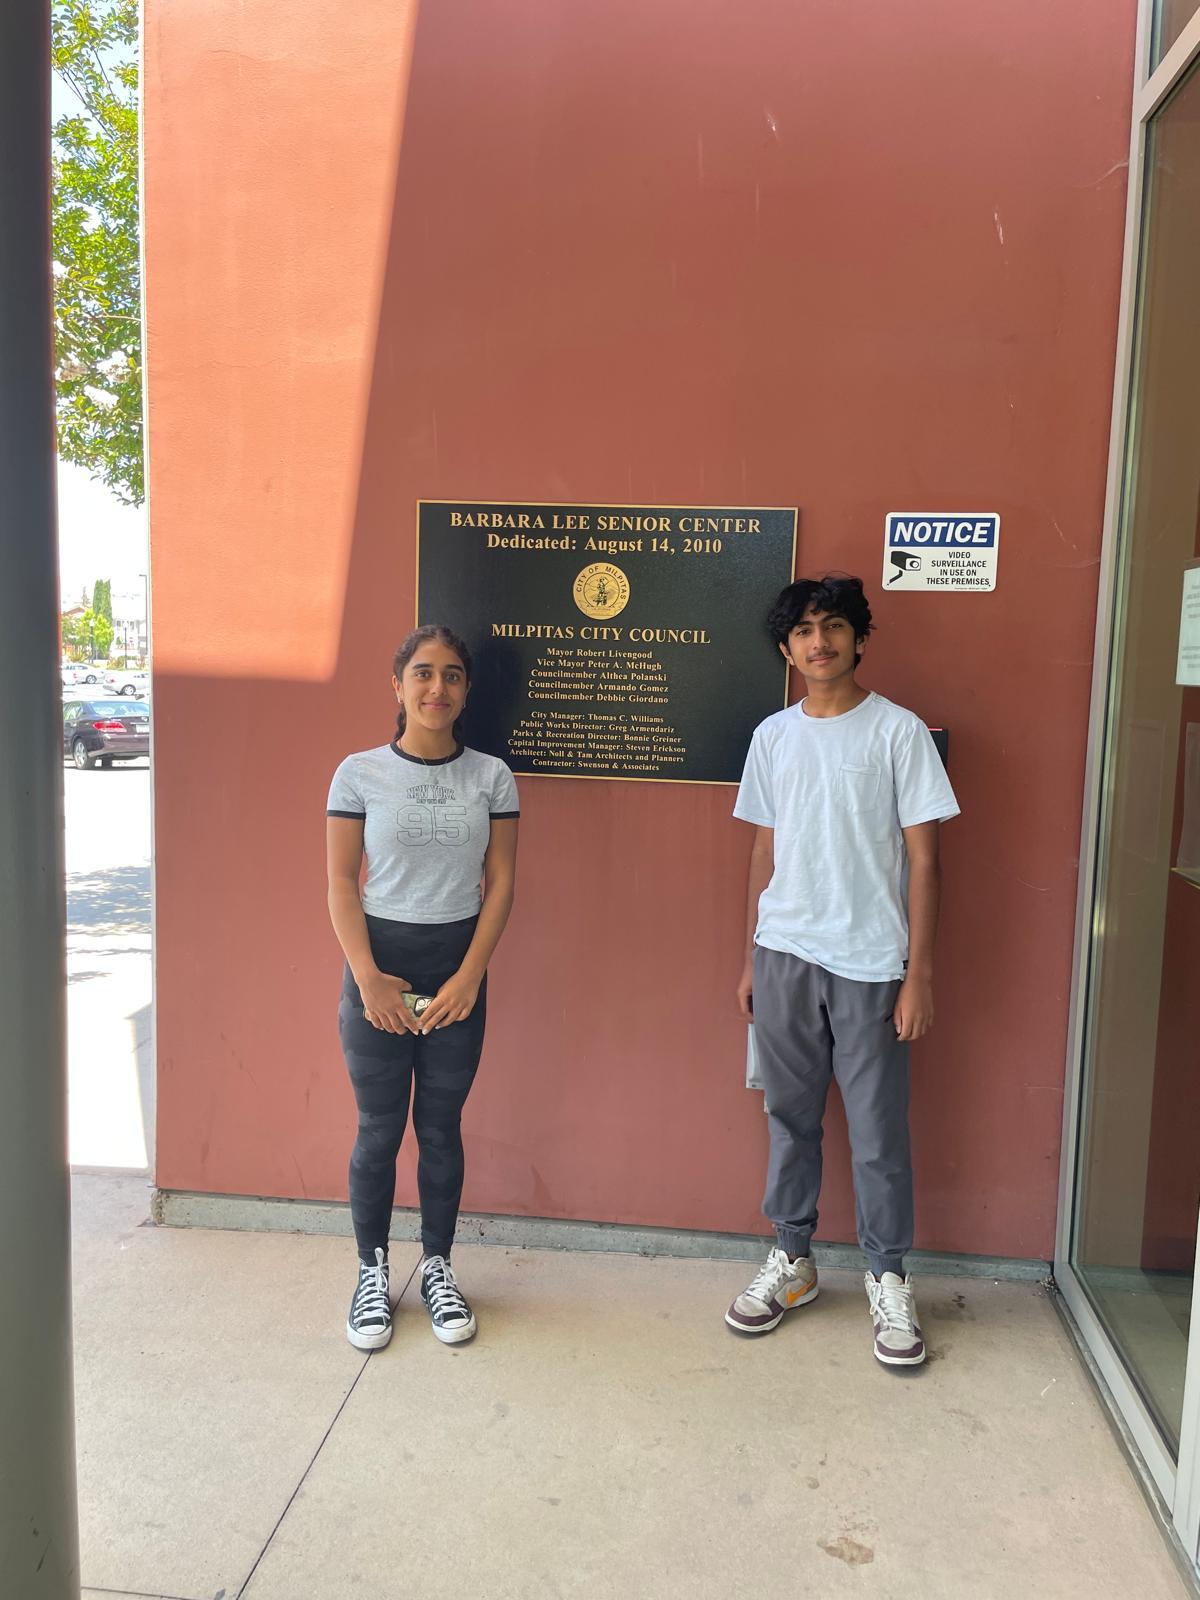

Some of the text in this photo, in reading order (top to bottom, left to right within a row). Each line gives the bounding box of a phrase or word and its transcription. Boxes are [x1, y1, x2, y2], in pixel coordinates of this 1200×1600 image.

[450, 512, 760, 533] BARBARA LEE SENIOR CENTER
[894, 522, 991, 543] NOTICE
[487, 533, 722, 555] Dedicated: August 14, 2010
[576, 566, 626, 600] CITY OF MILPITAS
[491, 624, 711, 644] MILPITAS CITY COUNCIL
[547, 648, 574, 657] Mayor
[608, 650, 652, 659] Livengood
[537, 658, 555, 666] Vice
[558, 660, 584, 668] Mayor
[626, 662, 662, 671] McHugh
[531, 669, 597, 678] Councilmember
[631, 673, 667, 681] Polanski
[528, 680, 669, 692] Councilmember Armando Gomez
[528, 691, 669, 703] Councilmember Debbie Giordano
[531, 711, 547, 720] City
[550, 712, 585, 720] Manager:
[630, 715, 664, 723] Williams
[608, 724, 628, 732] Greg
[508, 738, 535, 747] Capital
[538, 740, 586, 748] Improvement
[588, 742, 624, 750] Manager:
[532, 758, 576, 767] Contractor:
[652, 754, 684, 762] Planners
[406, 784, 456, 800] NEW YORK
[397, 805, 470, 846] 95
